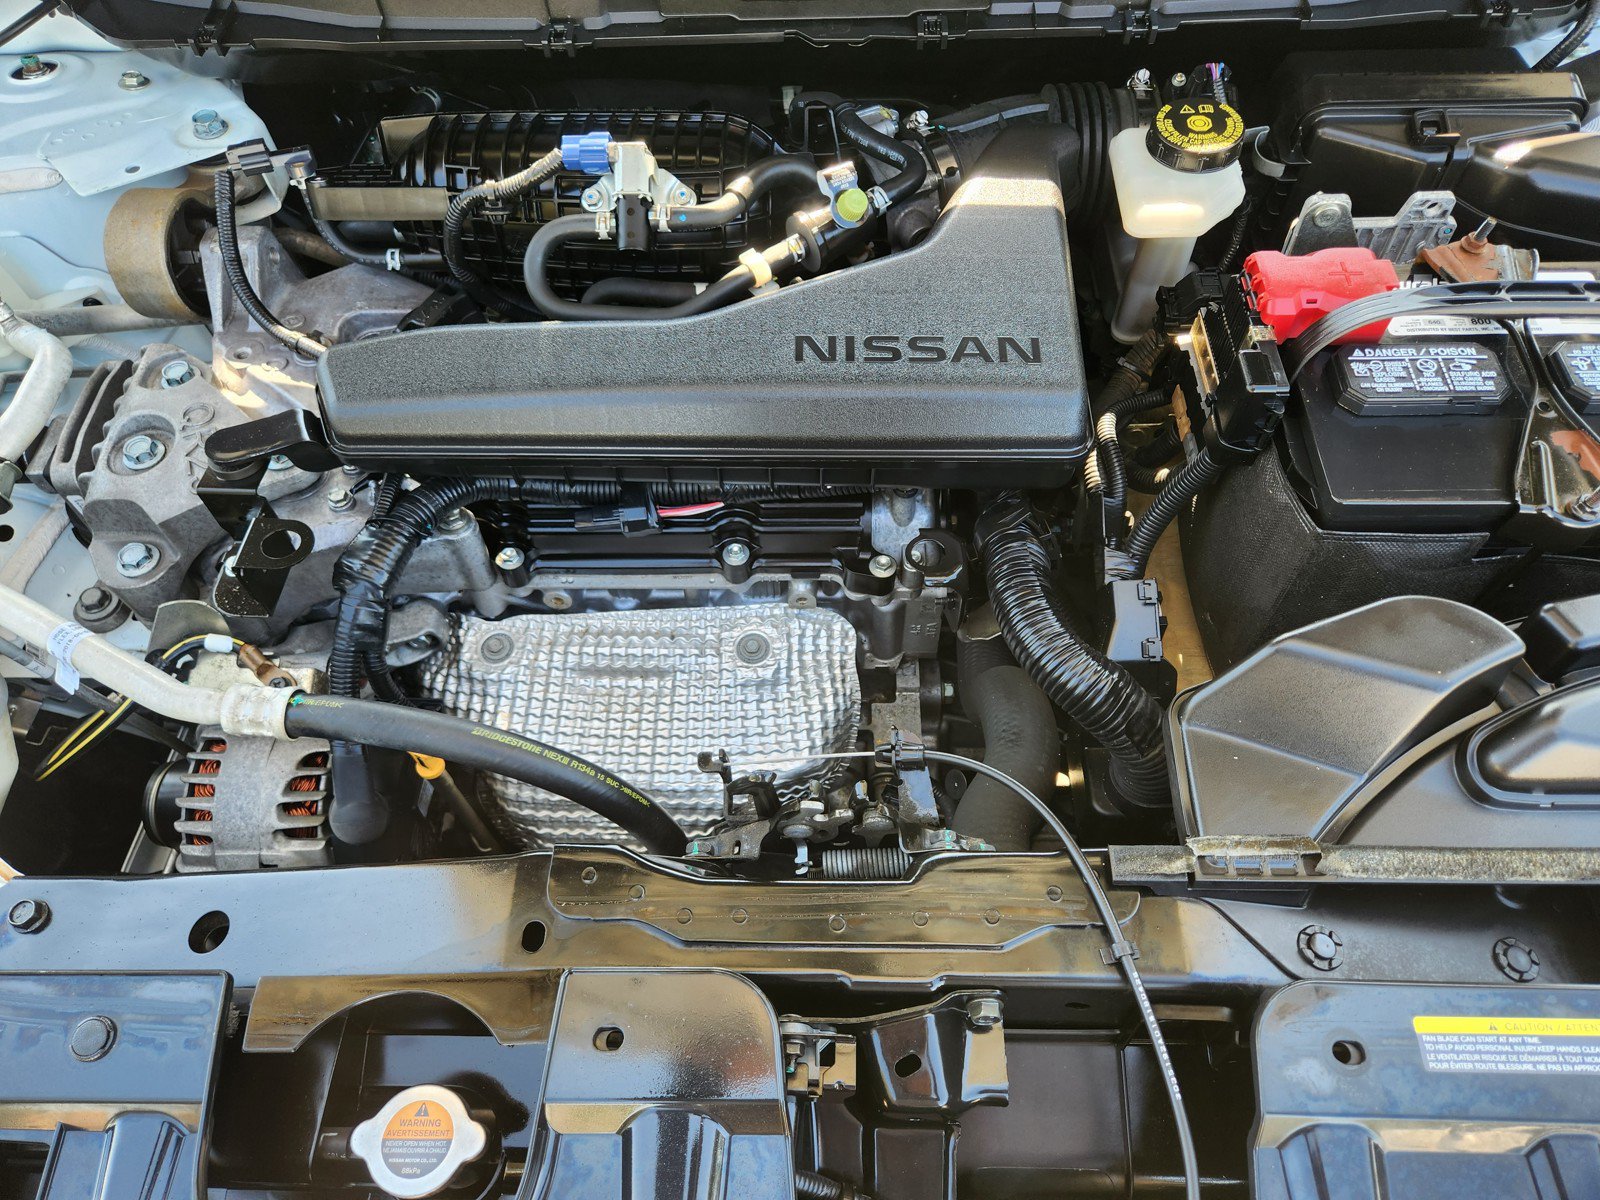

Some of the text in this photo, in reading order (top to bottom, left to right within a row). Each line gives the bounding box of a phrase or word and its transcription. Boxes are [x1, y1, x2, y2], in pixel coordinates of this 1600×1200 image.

[795, 335, 1041, 363] NISSAN
[1365, 348, 1417, 356] DANGER
[1429, 347, 1476, 356] POISON
[471, 726, 542, 754] BRIDGESTONE
[570, 760, 596, 777] R134a
[1504, 1022, 1553, 1032] CAUTION
[1424, 1043, 1434, 1051] TO
[1436, 1043, 1453, 1051] HELP
[1476, 1044, 1513, 1052] PERSONAL
[1436, 1053, 1481, 1061] VENTILATEUR
[1474, 1062, 1497, 1070] TOUTE
[400, 1119, 441, 1127] WARNING
